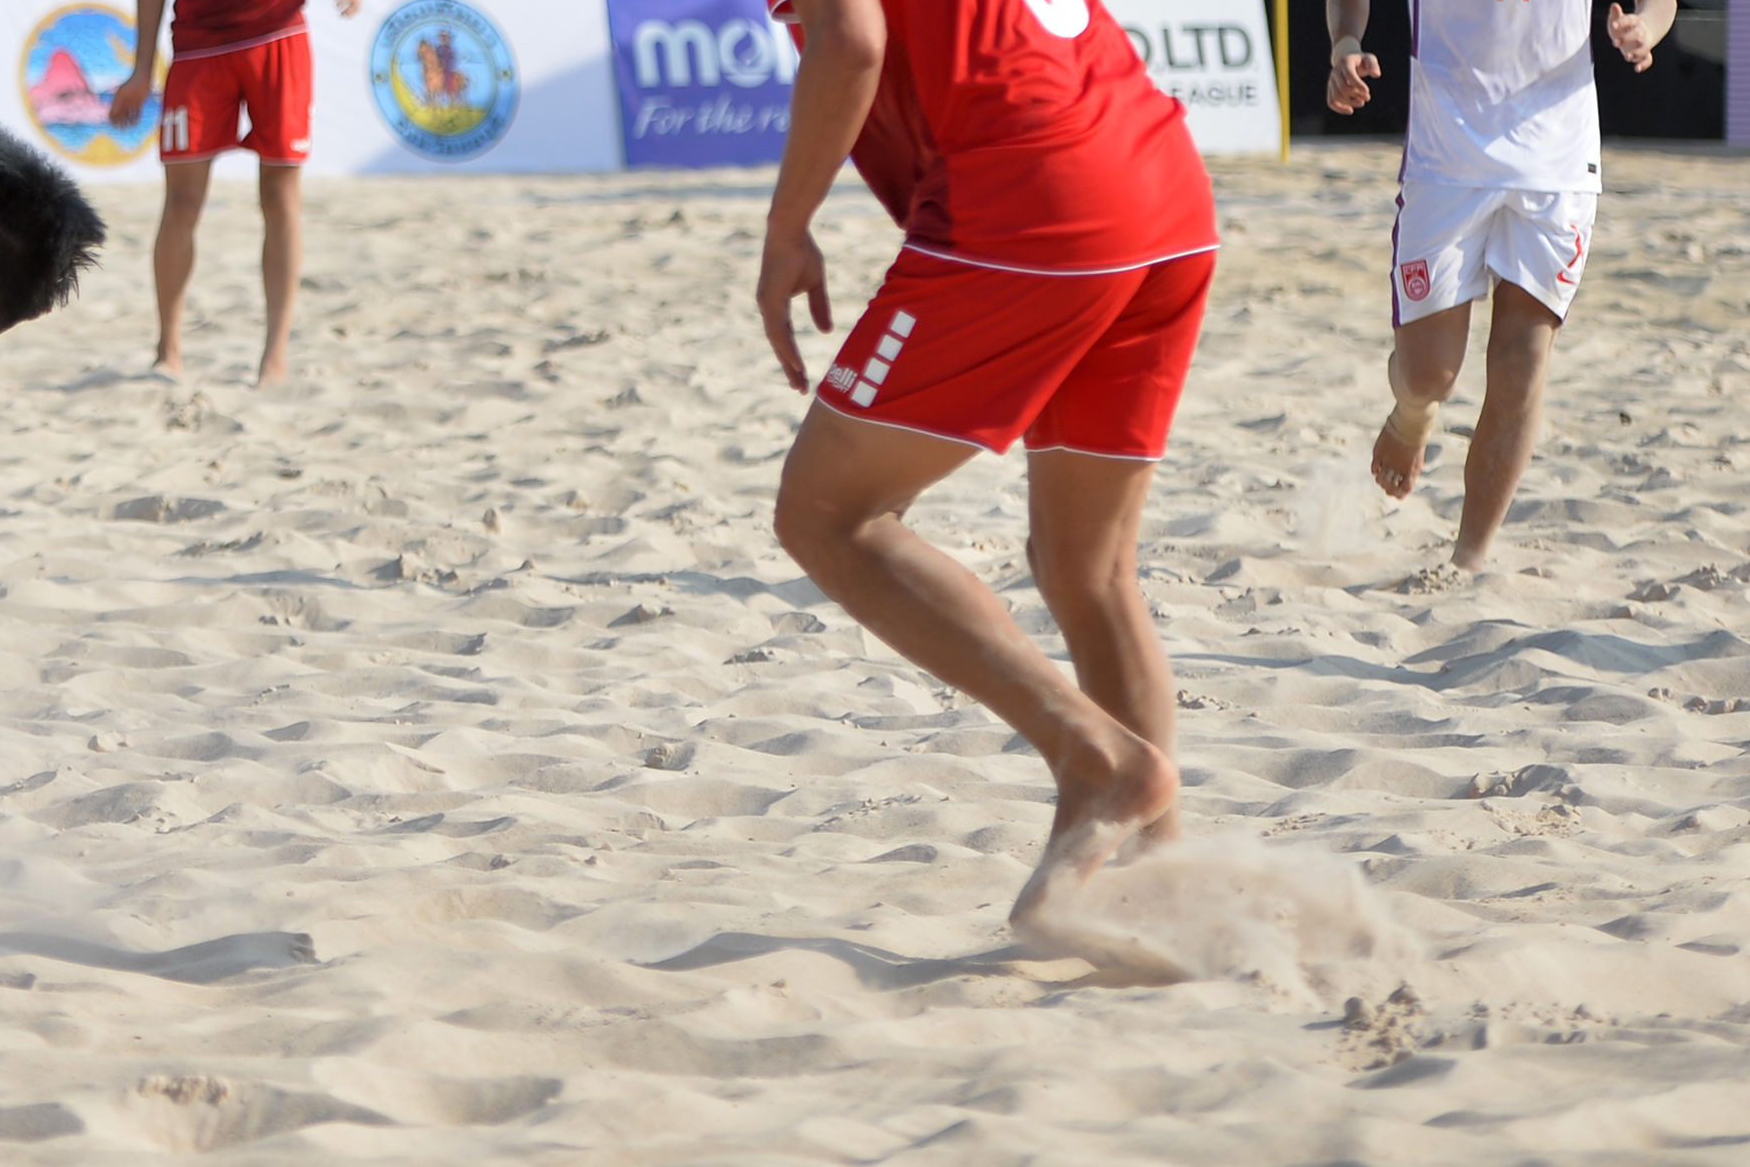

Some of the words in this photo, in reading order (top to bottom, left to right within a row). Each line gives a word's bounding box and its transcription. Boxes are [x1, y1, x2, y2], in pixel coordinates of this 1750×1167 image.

[161, 105, 190, 153] 11
[632, 93, 695, 140] For
[697, 91, 755, 135] the
